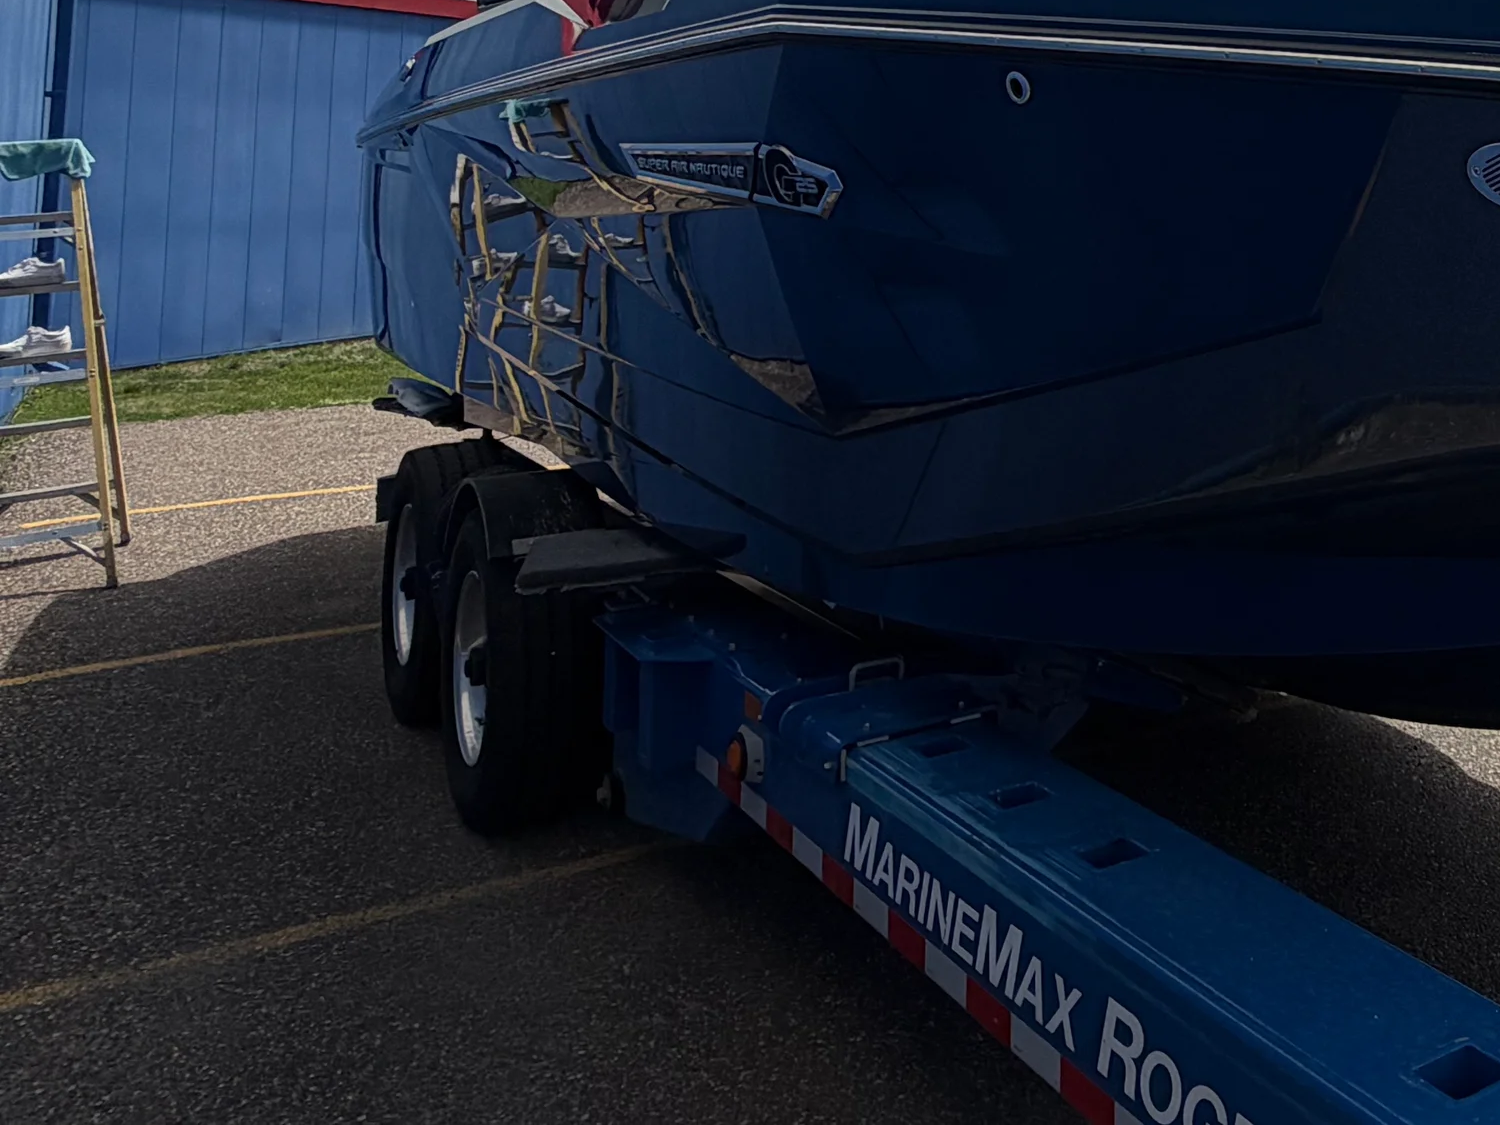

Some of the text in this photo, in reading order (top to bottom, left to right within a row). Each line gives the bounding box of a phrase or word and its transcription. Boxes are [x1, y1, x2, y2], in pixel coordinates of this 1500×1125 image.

[637, 156, 745, 179] SUPER AIR NAUTIQUE
[1097, 995, 1255, 1125] ROG
